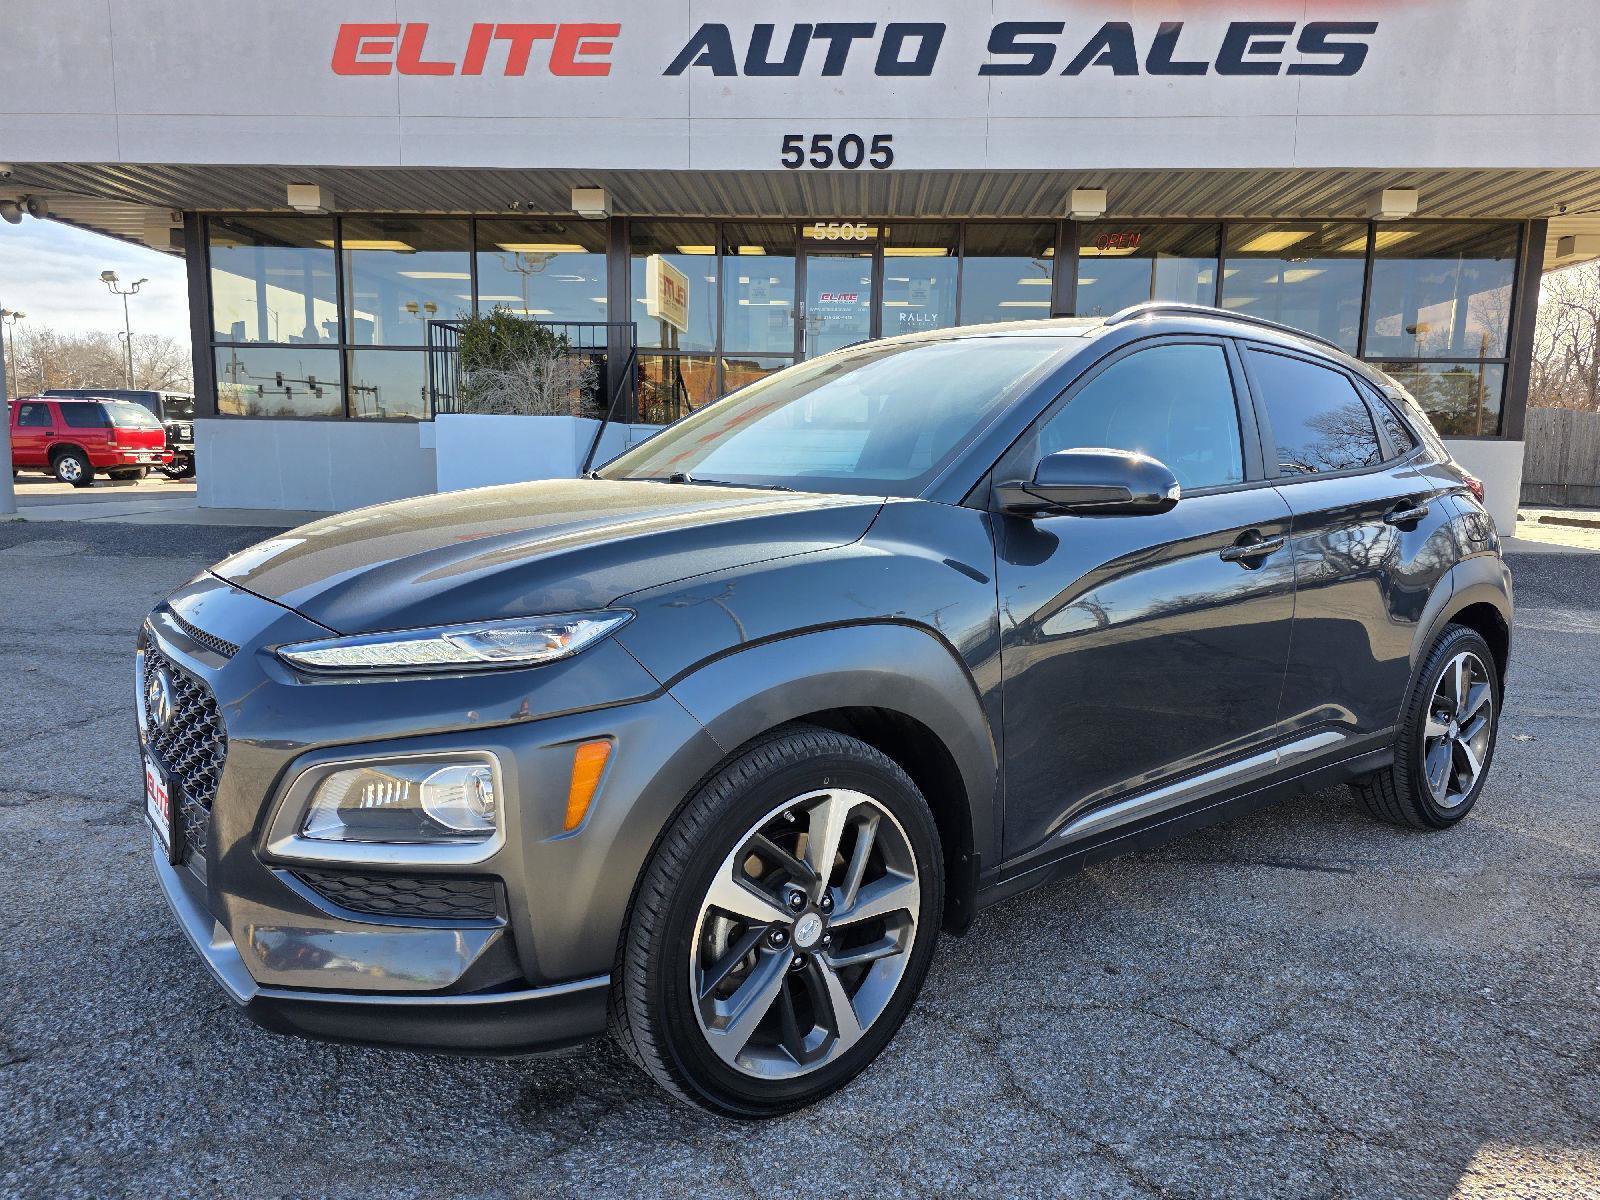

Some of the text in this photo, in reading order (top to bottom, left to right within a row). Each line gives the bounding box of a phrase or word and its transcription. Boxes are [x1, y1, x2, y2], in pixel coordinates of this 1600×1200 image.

[331, 21, 1379, 76] ELITE AUTO SALES
[781, 133, 894, 169] 5505
[813, 222, 868, 240] 5505
[1096, 231, 1142, 250] OPEN
[820, 292, 859, 302] ELITE
[899, 312, 938, 322] RALLY
